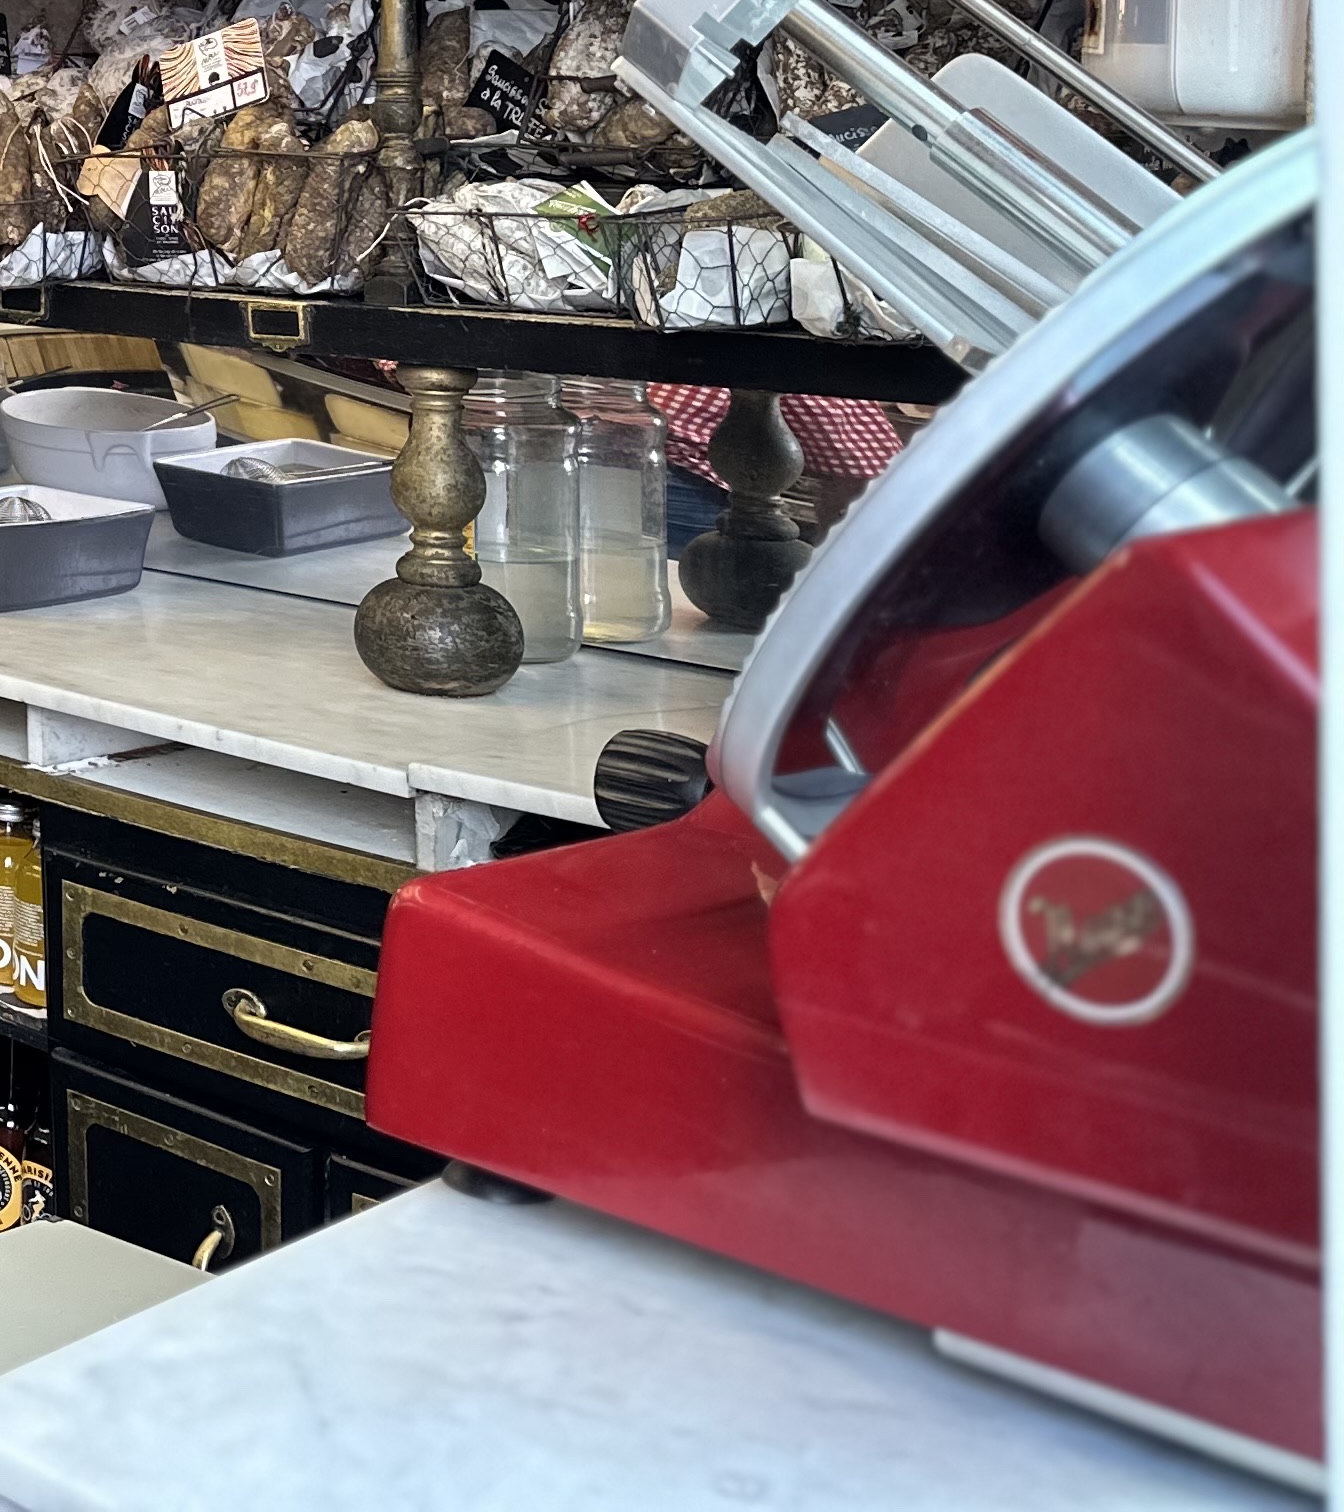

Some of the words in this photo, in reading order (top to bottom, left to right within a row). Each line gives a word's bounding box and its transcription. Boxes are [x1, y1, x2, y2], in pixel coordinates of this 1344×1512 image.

[485, 64, 529, 106] Saucisso
[491, 93, 502, 111] la
[153, 224, 179, 234] SON
